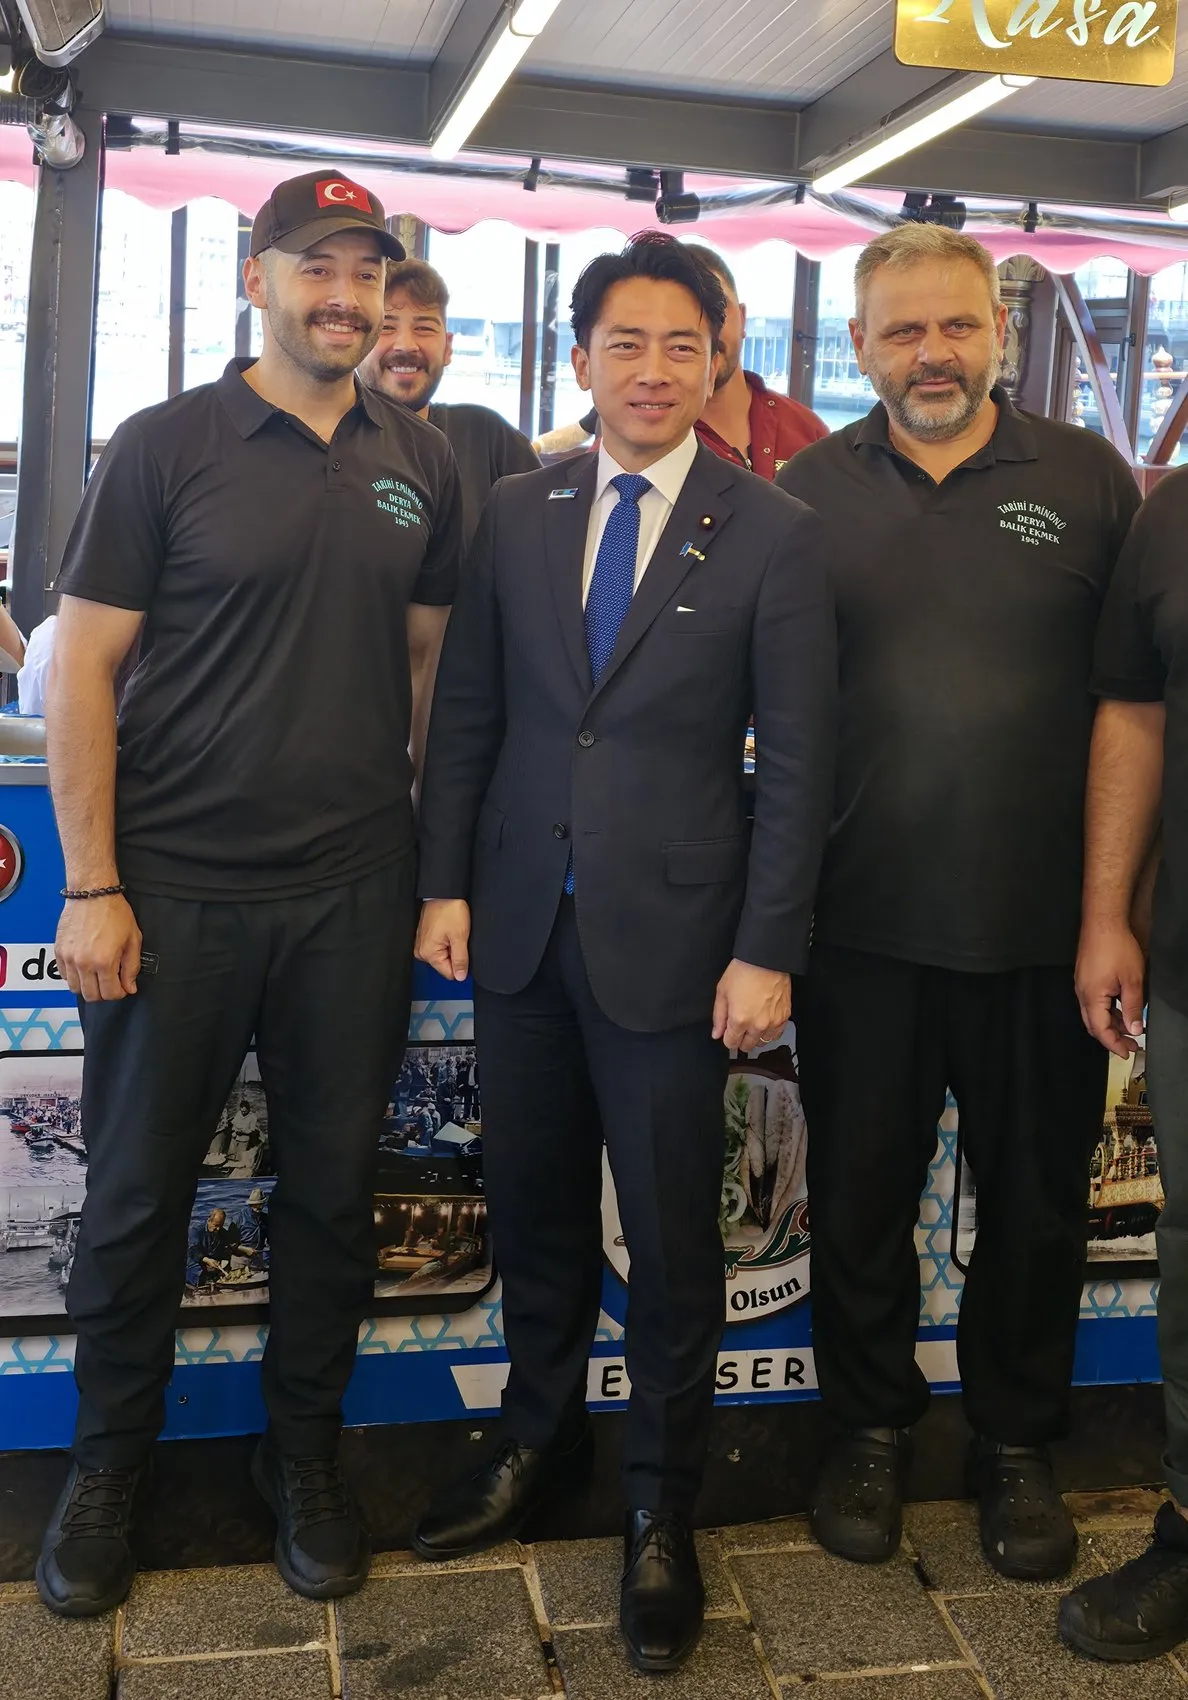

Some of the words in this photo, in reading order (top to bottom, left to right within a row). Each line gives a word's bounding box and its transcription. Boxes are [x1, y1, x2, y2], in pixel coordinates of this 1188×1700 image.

[372, 477, 395, 492] TARİHİ
[389, 493, 412, 509] DERYA
[377, 499, 399, 514] BALIK
[400, 508, 421, 525] EKMEK
[997, 500, 1027, 514] TARİHİ
[1029, 503, 1067, 530] EMİNÖNÜ
[1017, 514, 1046, 529] DERYA
[1000, 520, 1027, 533] BALIK
[1029, 528, 1060, 544] EKMEK
[1021, 535, 1040, 546] 1945
[731, 1276, 802, 1311] Olsun
